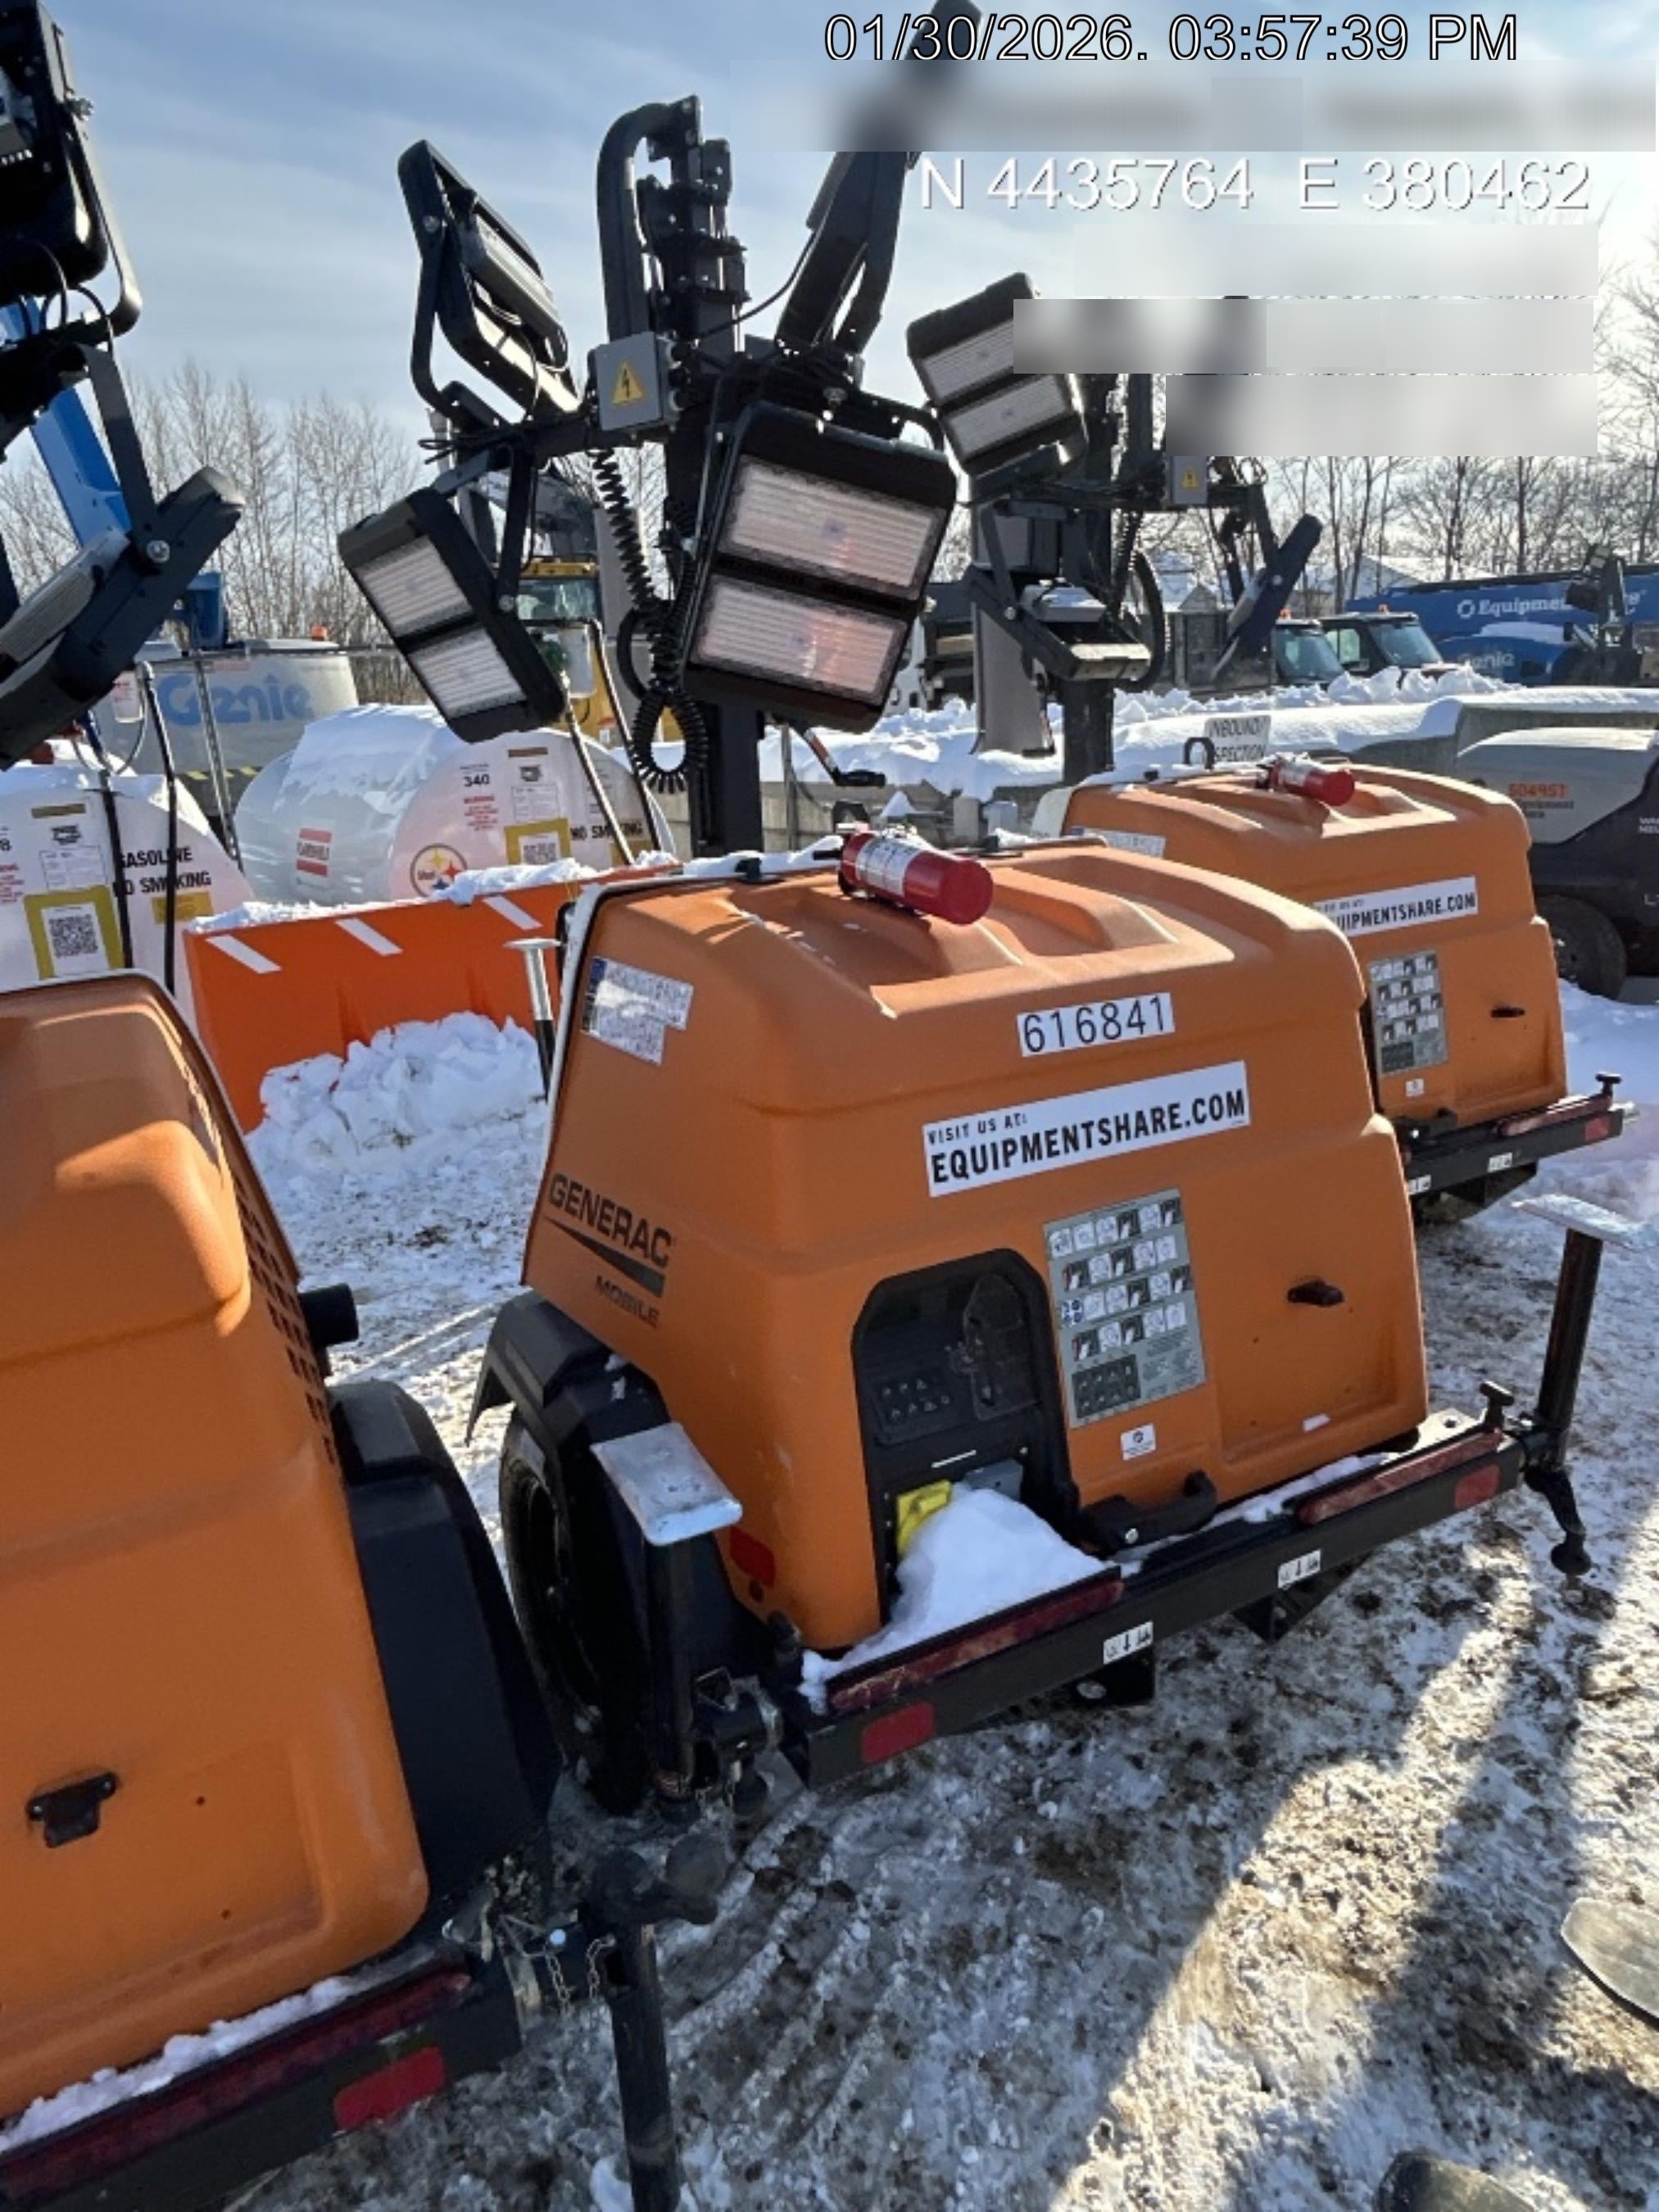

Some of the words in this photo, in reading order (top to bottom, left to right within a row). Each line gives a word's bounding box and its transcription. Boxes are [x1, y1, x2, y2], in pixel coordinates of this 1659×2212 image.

[1478, 597, 1574, 617] Equipme
[156, 670, 315, 727] Genie
[1216, 745, 1267, 762] SPECTION
[464, 774, 490, 787] 340
[591, 820, 643, 839] SMING
[120, 845, 193, 868] ASOLNE
[139, 872, 212, 894] SMKING
[1333, 892, 1475, 931] UIPMENTSHARE.COM
[1023, 995, 1164, 1054] 616841
[927, 1123, 969, 1145] VISIT
[977, 1117, 996, 1135] US
[1004, 1113, 1027, 1130] AT:
[931, 1089, 1245, 1184] EQUIPMENTSHARE.COM
[549, 1172, 672, 1268] GENERAC
[596, 1275, 660, 1330] MOBILE
